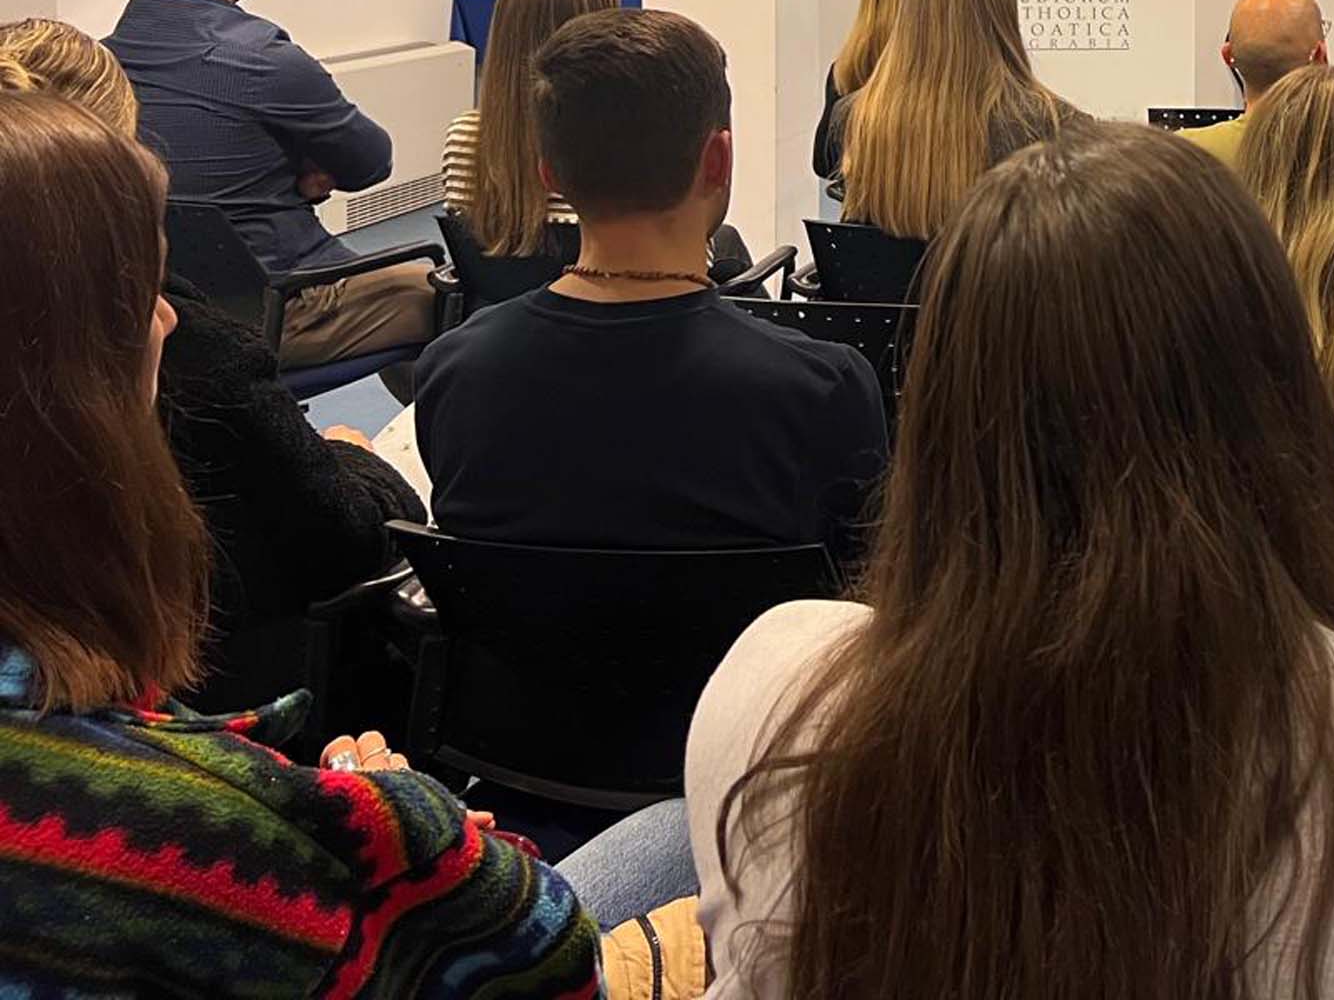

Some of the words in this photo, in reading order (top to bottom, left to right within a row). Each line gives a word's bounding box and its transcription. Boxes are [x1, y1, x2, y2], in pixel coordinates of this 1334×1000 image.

[1021, 6, 1129, 20] THOLICA
[1030, 23, 1129, 36] OATICA
[1029, 39, 1129, 49] GRABIA
